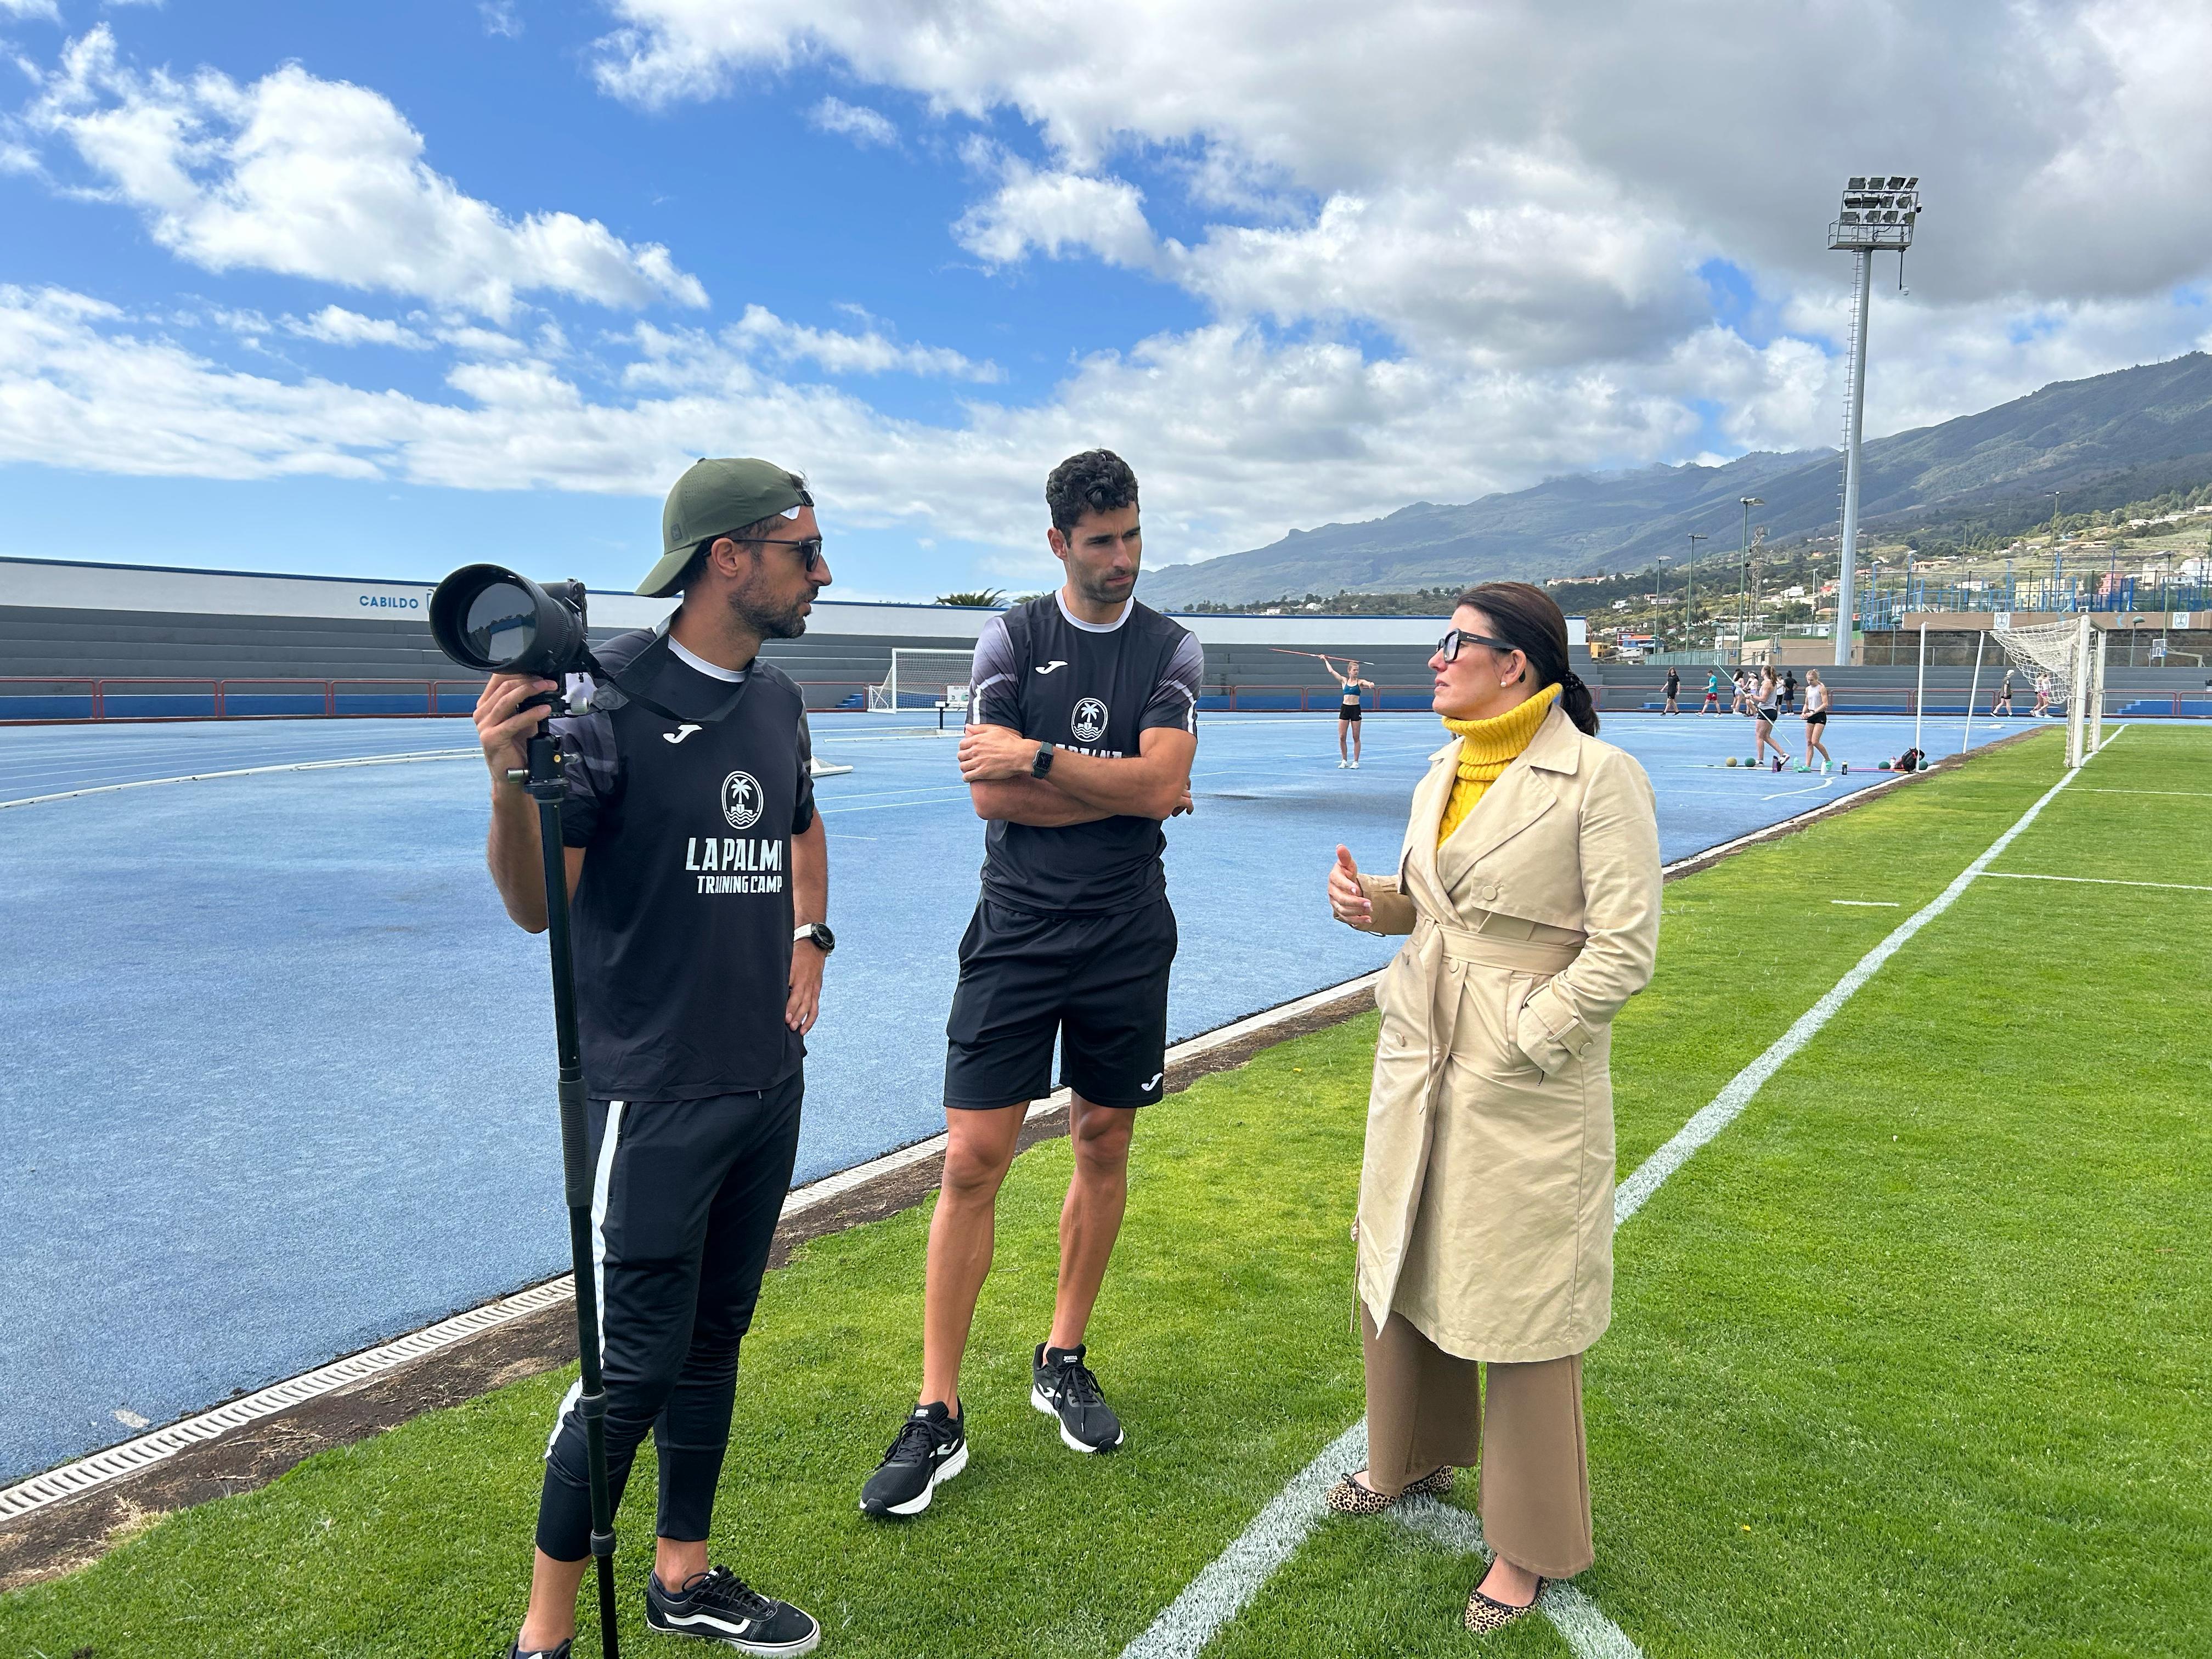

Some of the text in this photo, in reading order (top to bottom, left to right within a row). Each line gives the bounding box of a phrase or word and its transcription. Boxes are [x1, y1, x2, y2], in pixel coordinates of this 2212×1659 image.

[359, 596, 419, 609] CABILDO
[685, 837, 718, 871] LA
[751, 876, 782, 893] CAMP
